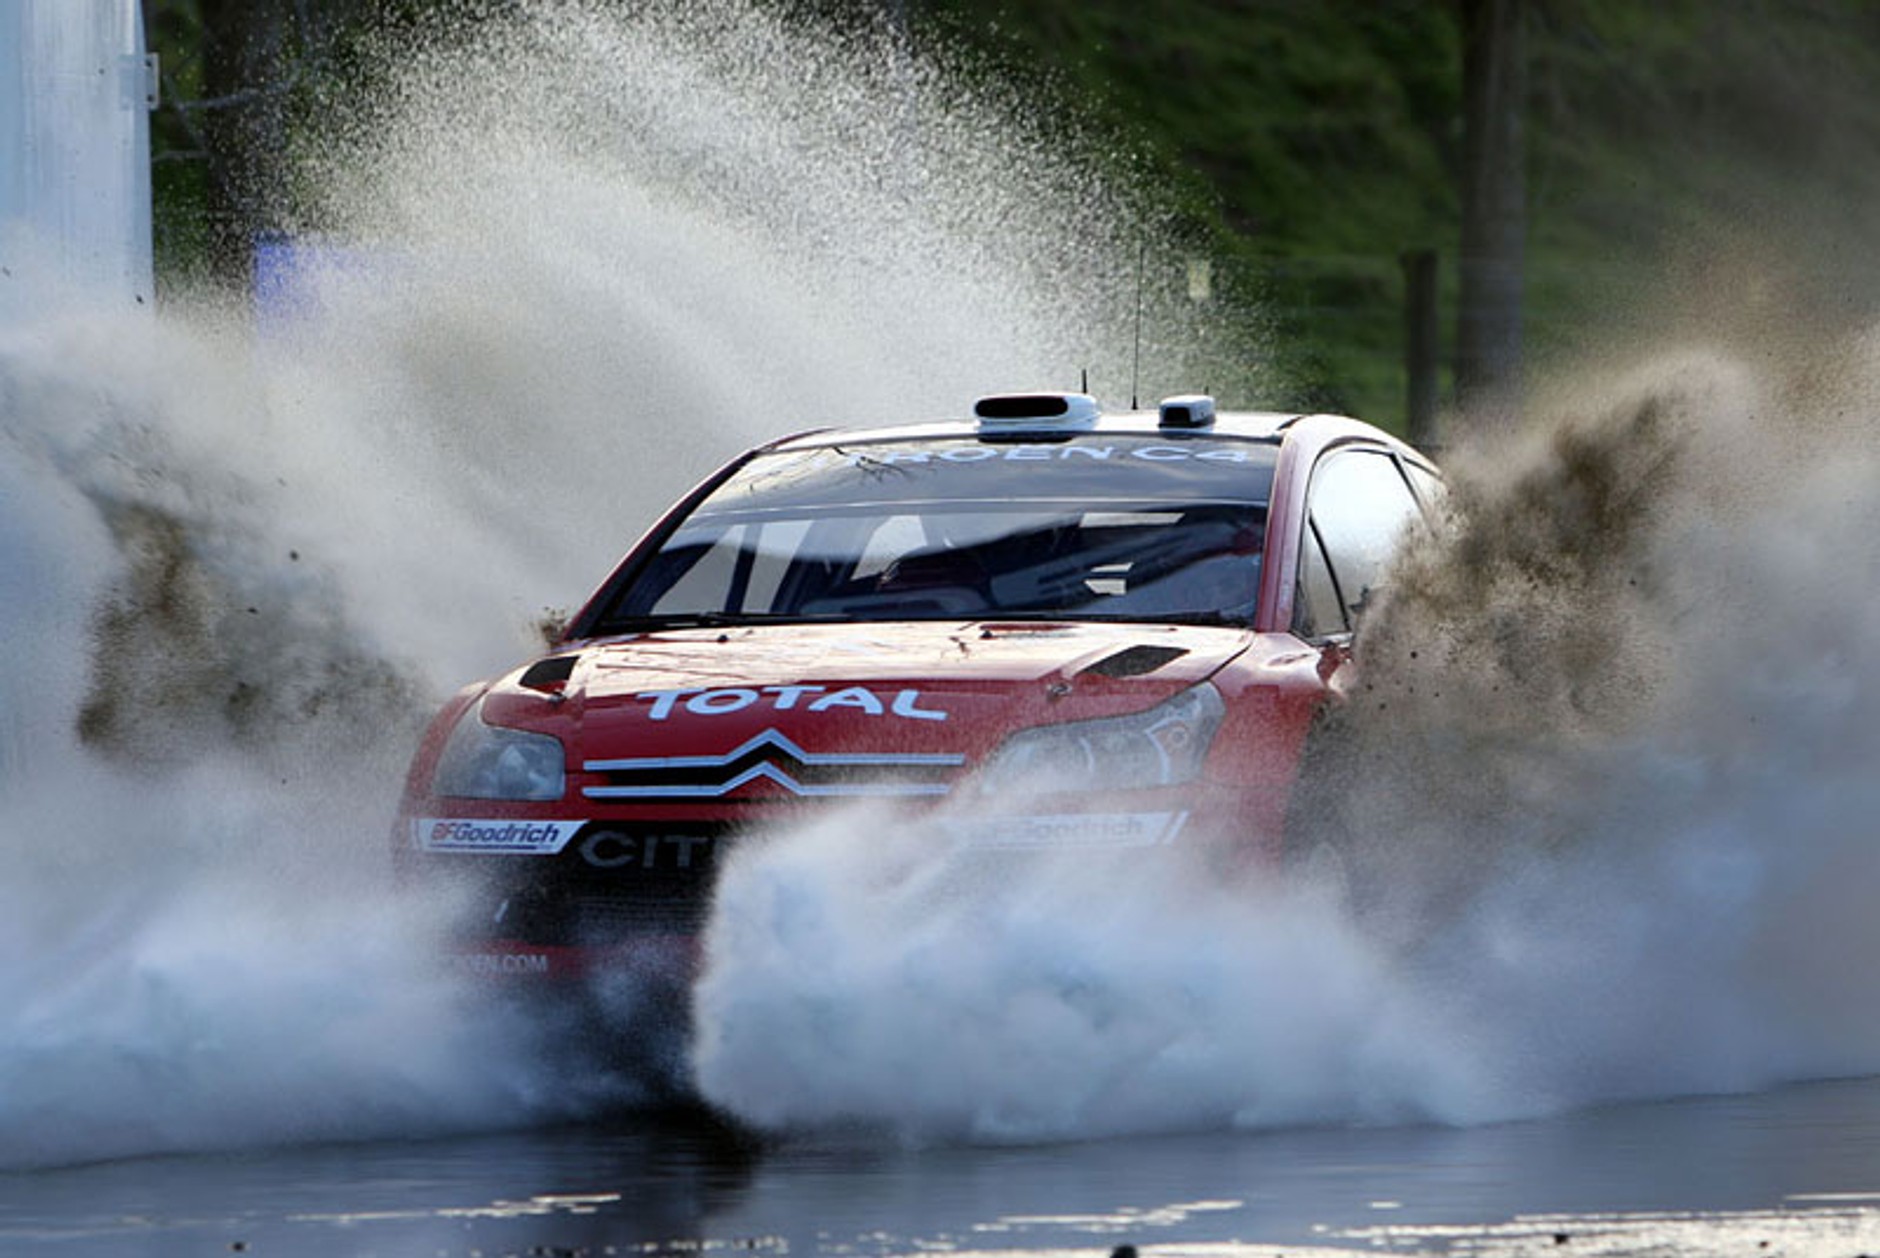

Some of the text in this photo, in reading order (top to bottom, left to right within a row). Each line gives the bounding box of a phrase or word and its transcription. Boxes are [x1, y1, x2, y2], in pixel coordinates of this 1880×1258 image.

[1131, 446, 1248, 462] C4
[637, 686, 948, 720] TOTAL
[431, 822, 561, 844] BFGoodrich
